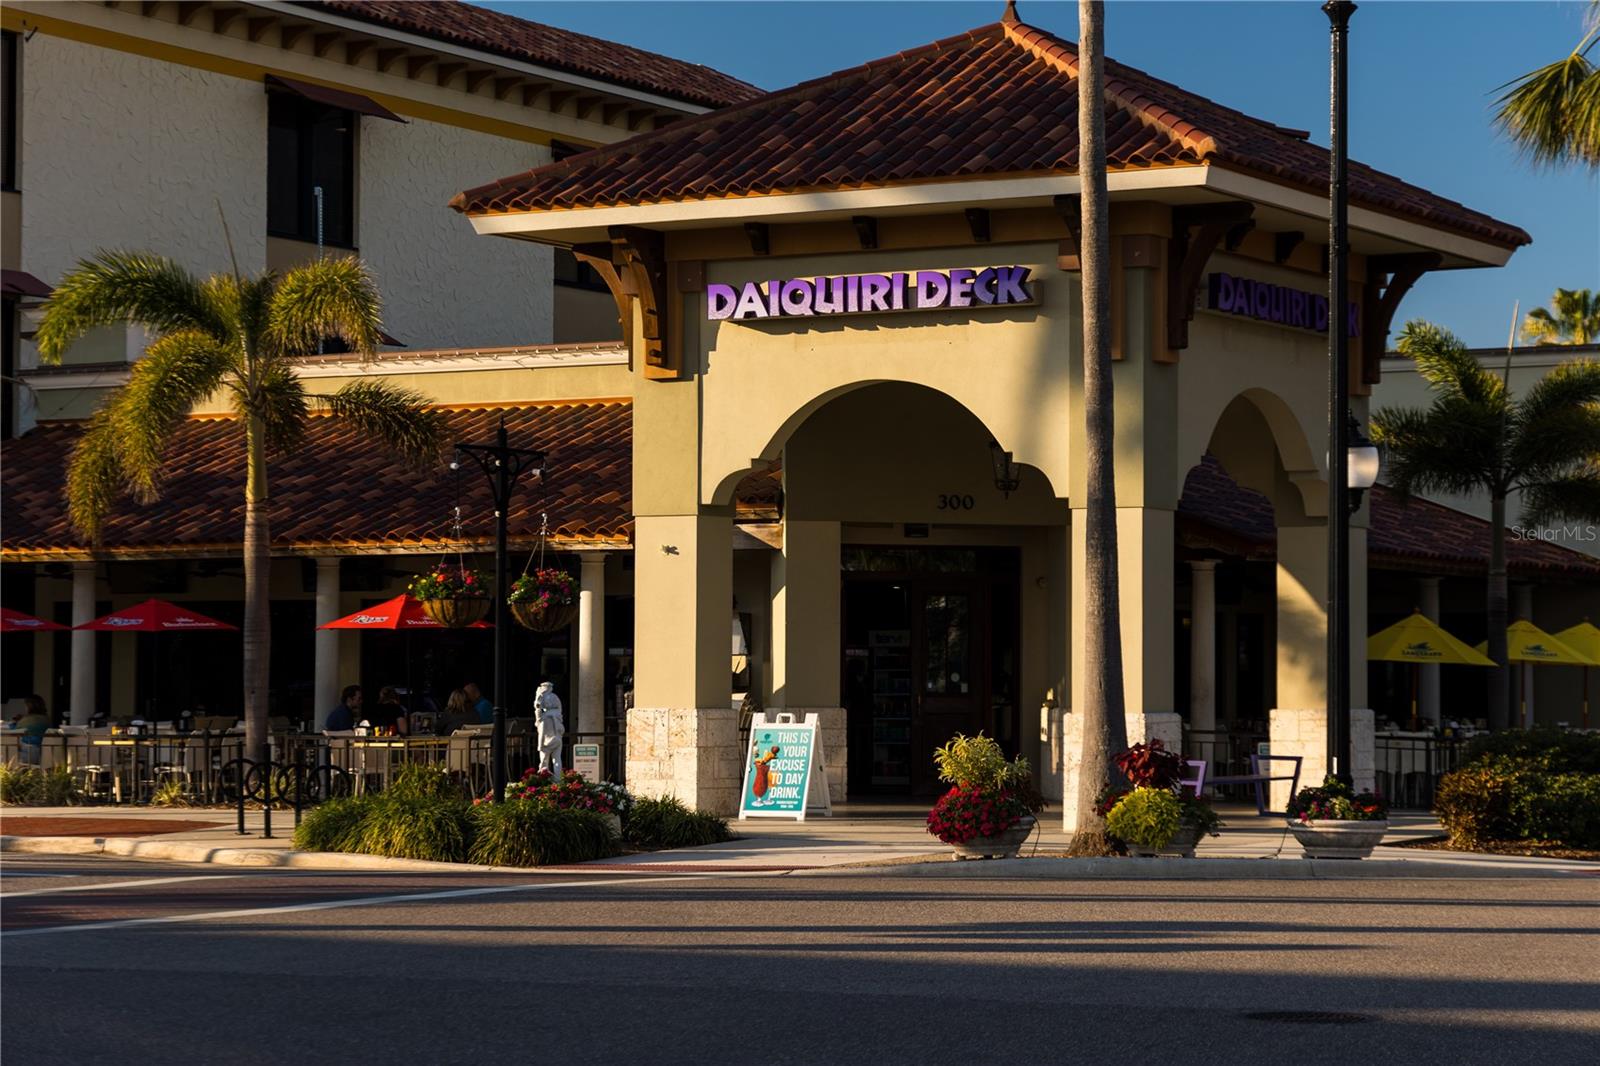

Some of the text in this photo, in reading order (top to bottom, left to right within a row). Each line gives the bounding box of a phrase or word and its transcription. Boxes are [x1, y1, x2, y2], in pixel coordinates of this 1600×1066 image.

[707, 265, 1031, 320] DAIQUIRI DECK
[1217, 272, 1360, 337] DAIQUIRI DK
[937, 494, 974, 510] 300
[777, 731, 809, 743] THIS IS
[783, 745, 807, 758] YOUR
[769, 759, 806, 771] EXCUSE
[771, 772, 804, 785] TO DAY
[770, 786, 801, 799] DRINK.
